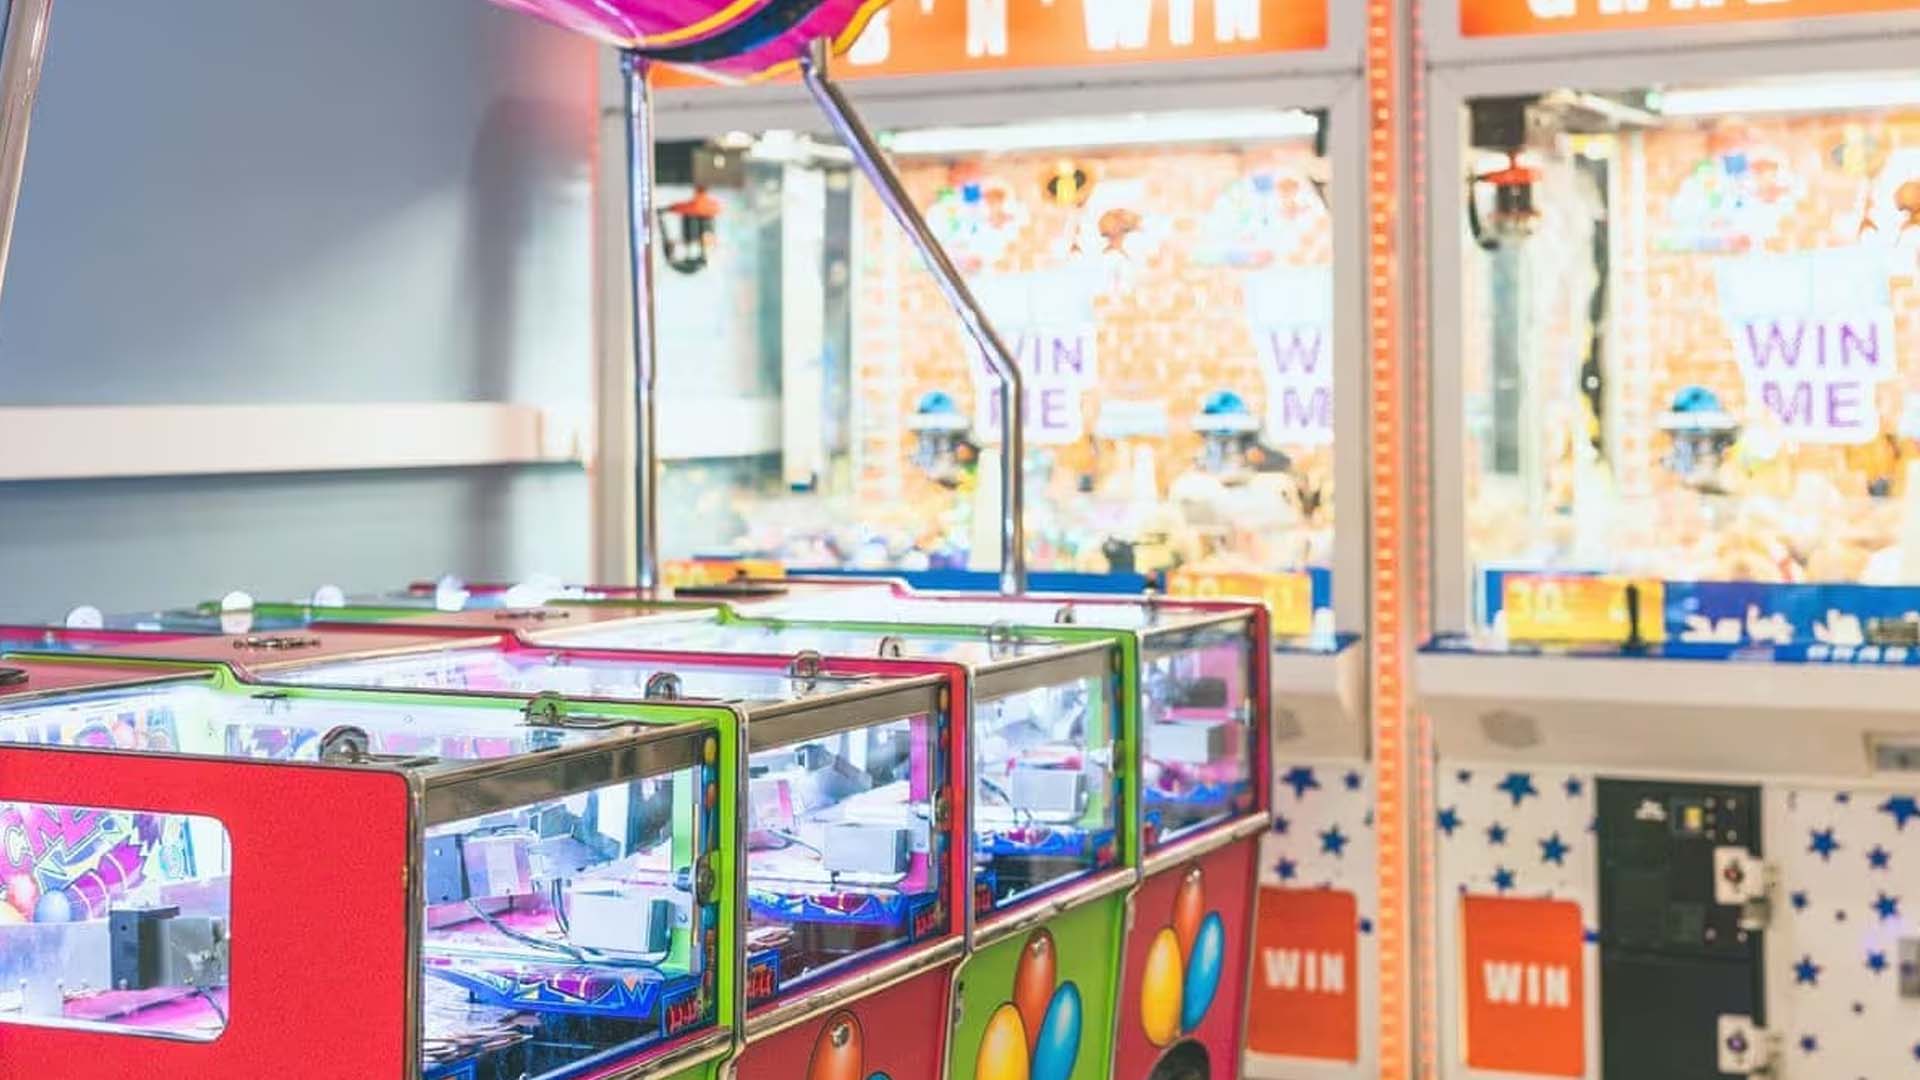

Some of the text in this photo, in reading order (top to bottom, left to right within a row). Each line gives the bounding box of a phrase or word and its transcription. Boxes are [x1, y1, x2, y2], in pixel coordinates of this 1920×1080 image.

[1084, 0, 1259, 50] WIN
[1745, 320, 1879, 368] WIN
[1763, 379, 1862, 428] ME
[1263, 948, 1346, 994] WIN
[1483, 960, 1570, 1008] WIN
